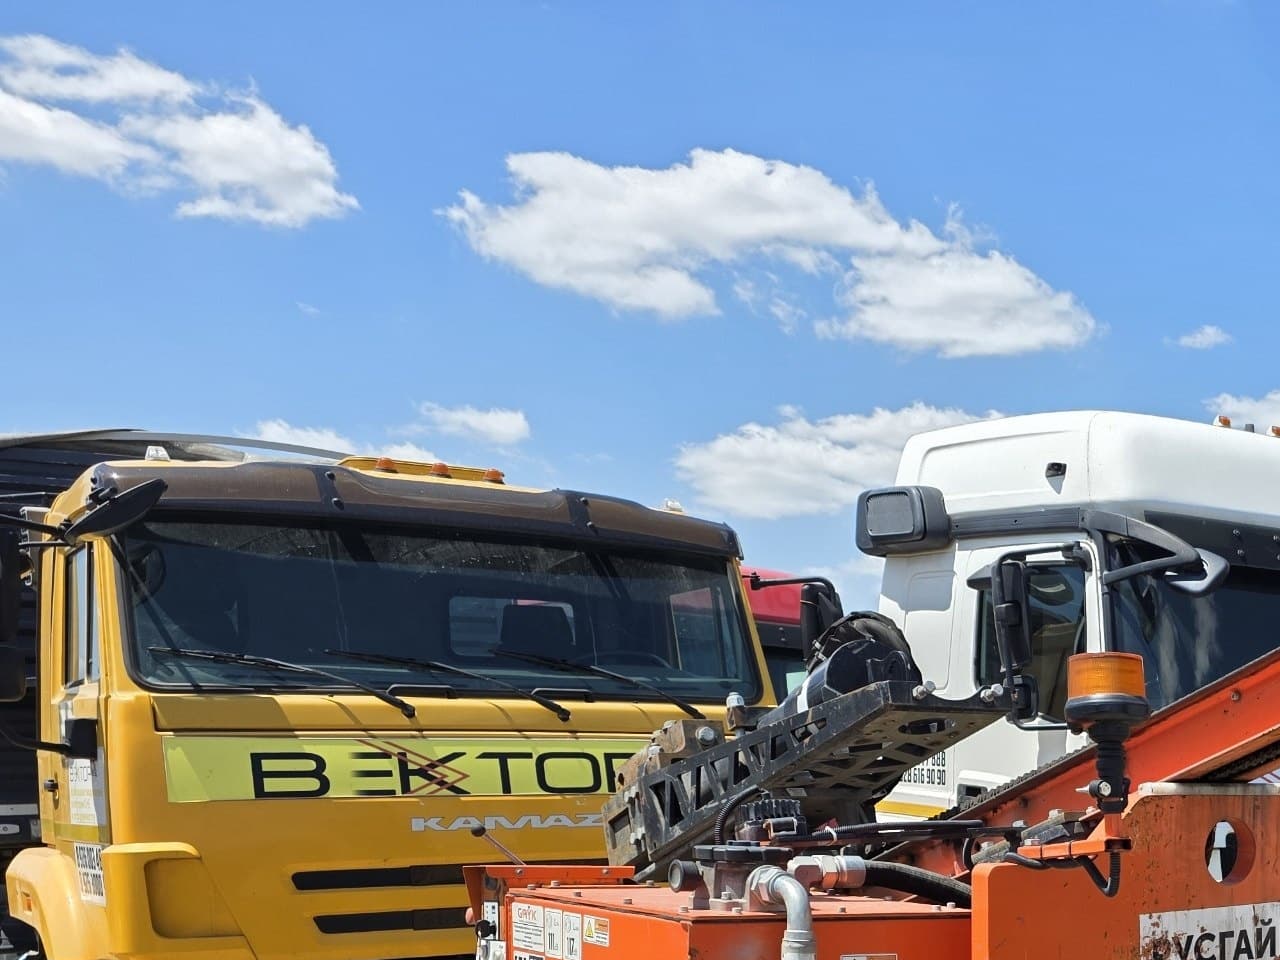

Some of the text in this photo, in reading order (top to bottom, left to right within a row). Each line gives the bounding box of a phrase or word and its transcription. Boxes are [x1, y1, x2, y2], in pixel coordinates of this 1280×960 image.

[913, 768, 925, 784] 616
[926, 769, 936, 785] 90
[937, 769, 946, 786] 90
[411, 813, 603, 832] KAMAZ
